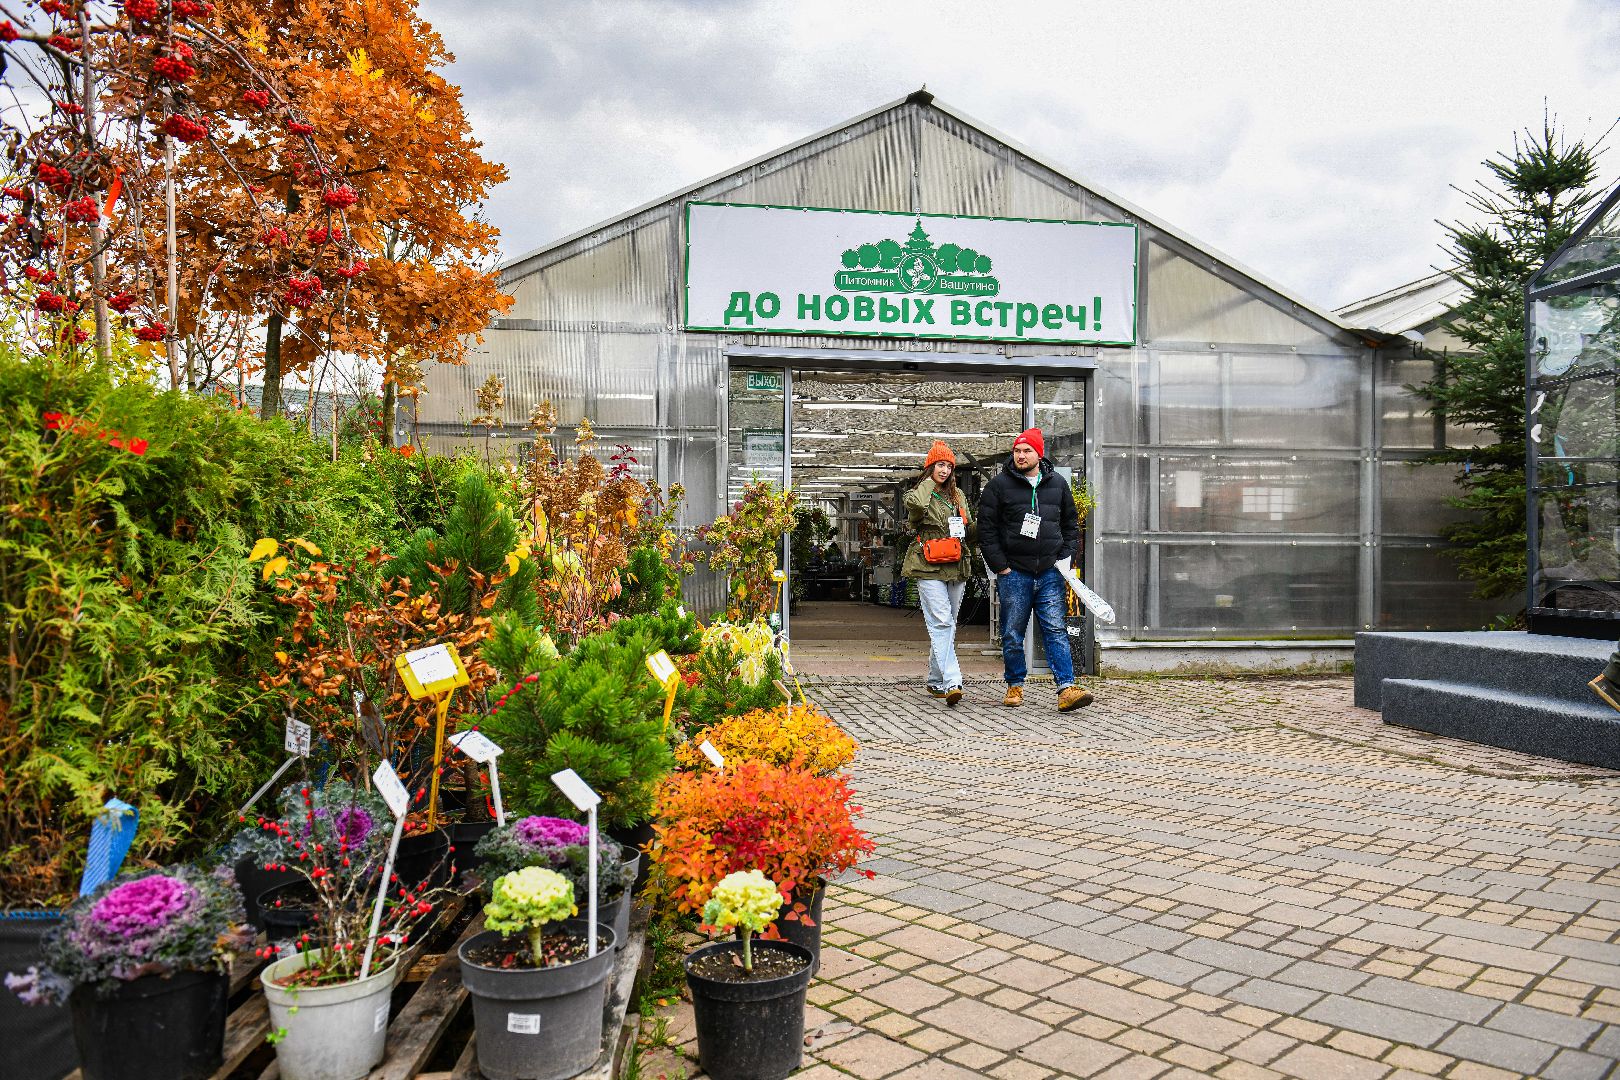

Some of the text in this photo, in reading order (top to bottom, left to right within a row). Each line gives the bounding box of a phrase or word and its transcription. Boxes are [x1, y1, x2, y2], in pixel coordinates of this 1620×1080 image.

[840, 274, 995, 292] Питомник Вашутино
[797, 293, 936, 324] новых
[950, 296, 1102, 336] встреч!
[748, 374, 783, 388] ВЫХОД
